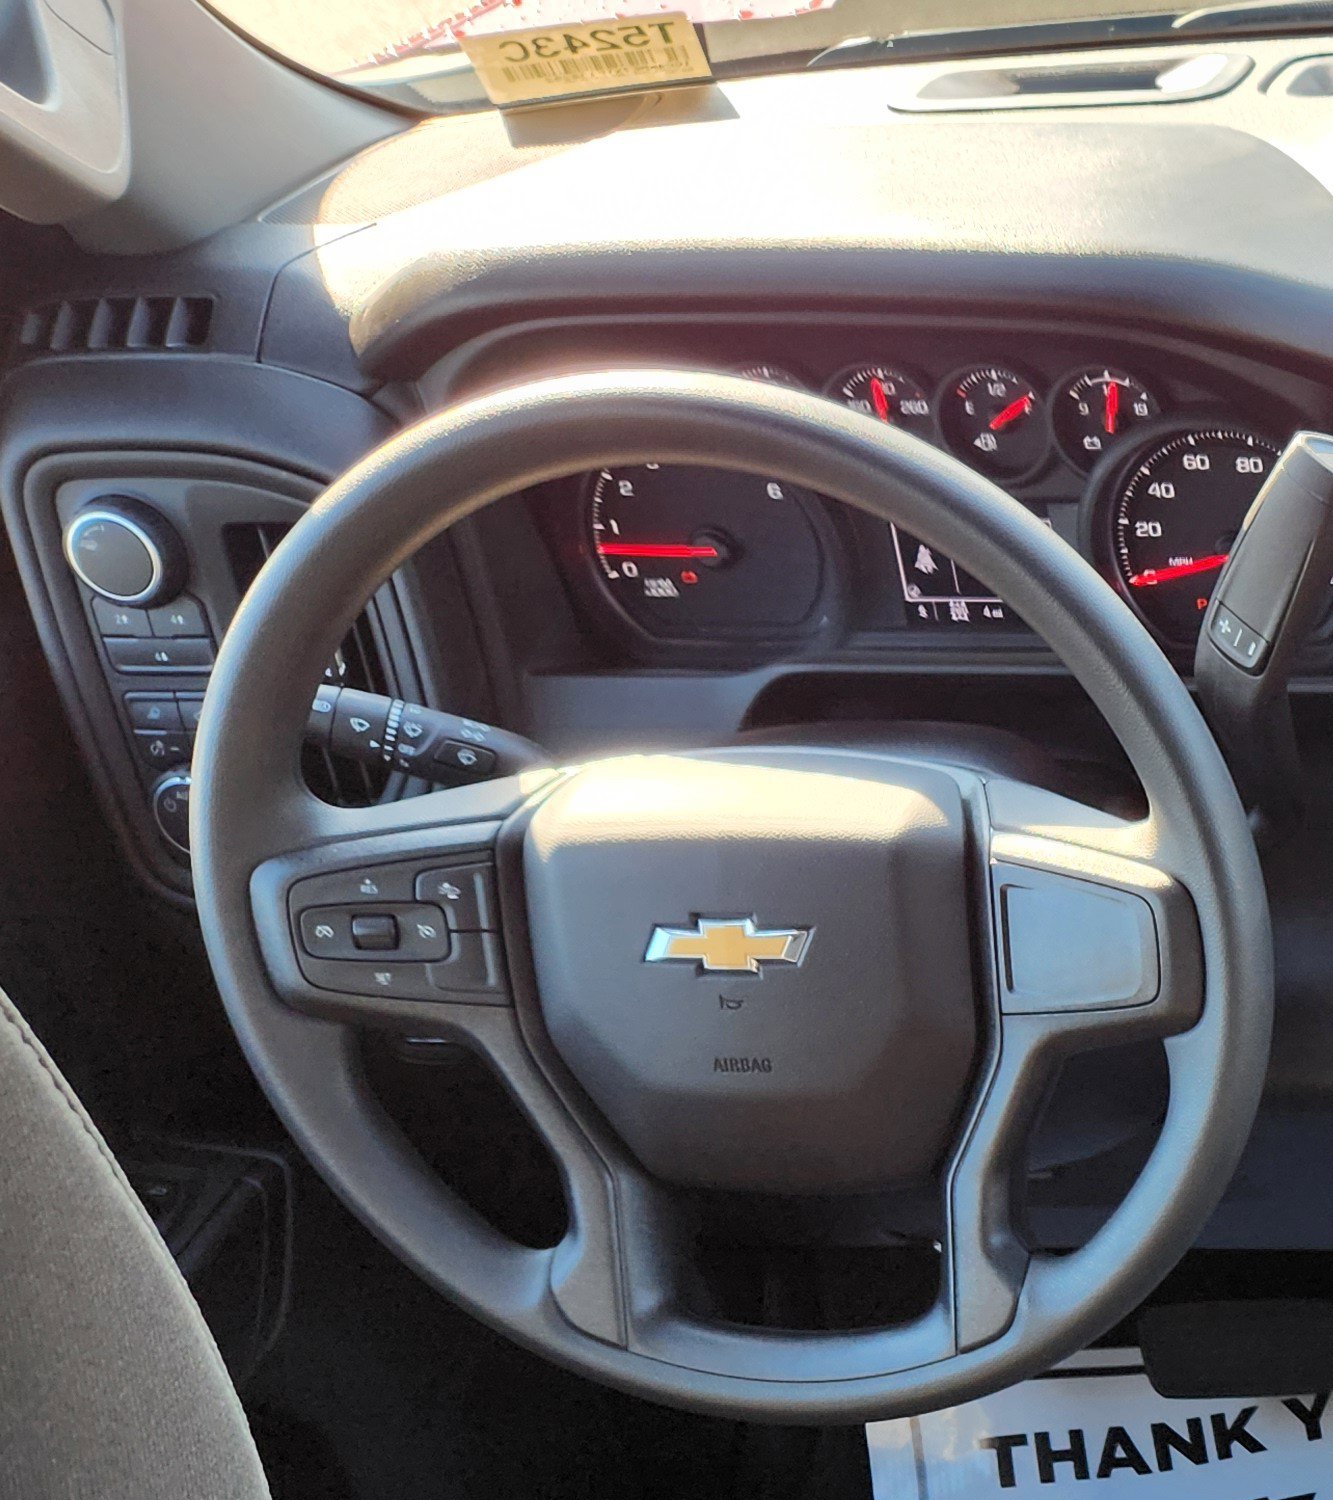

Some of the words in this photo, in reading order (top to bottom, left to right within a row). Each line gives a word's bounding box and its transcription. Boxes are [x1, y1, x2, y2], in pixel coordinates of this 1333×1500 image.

[1182, 454, 1210, 470] 60
[1235, 456, 1263, 473] 80
[1147, 482, 1176, 499] 40
[1134, 521, 1162, 537] 20
[622, 561, 639, 578] 0
[1197, 598, 1208, 609] P
[713, 1057, 773, 1074] AIRBAG
[978, 1405, 1268, 1489] THANK
